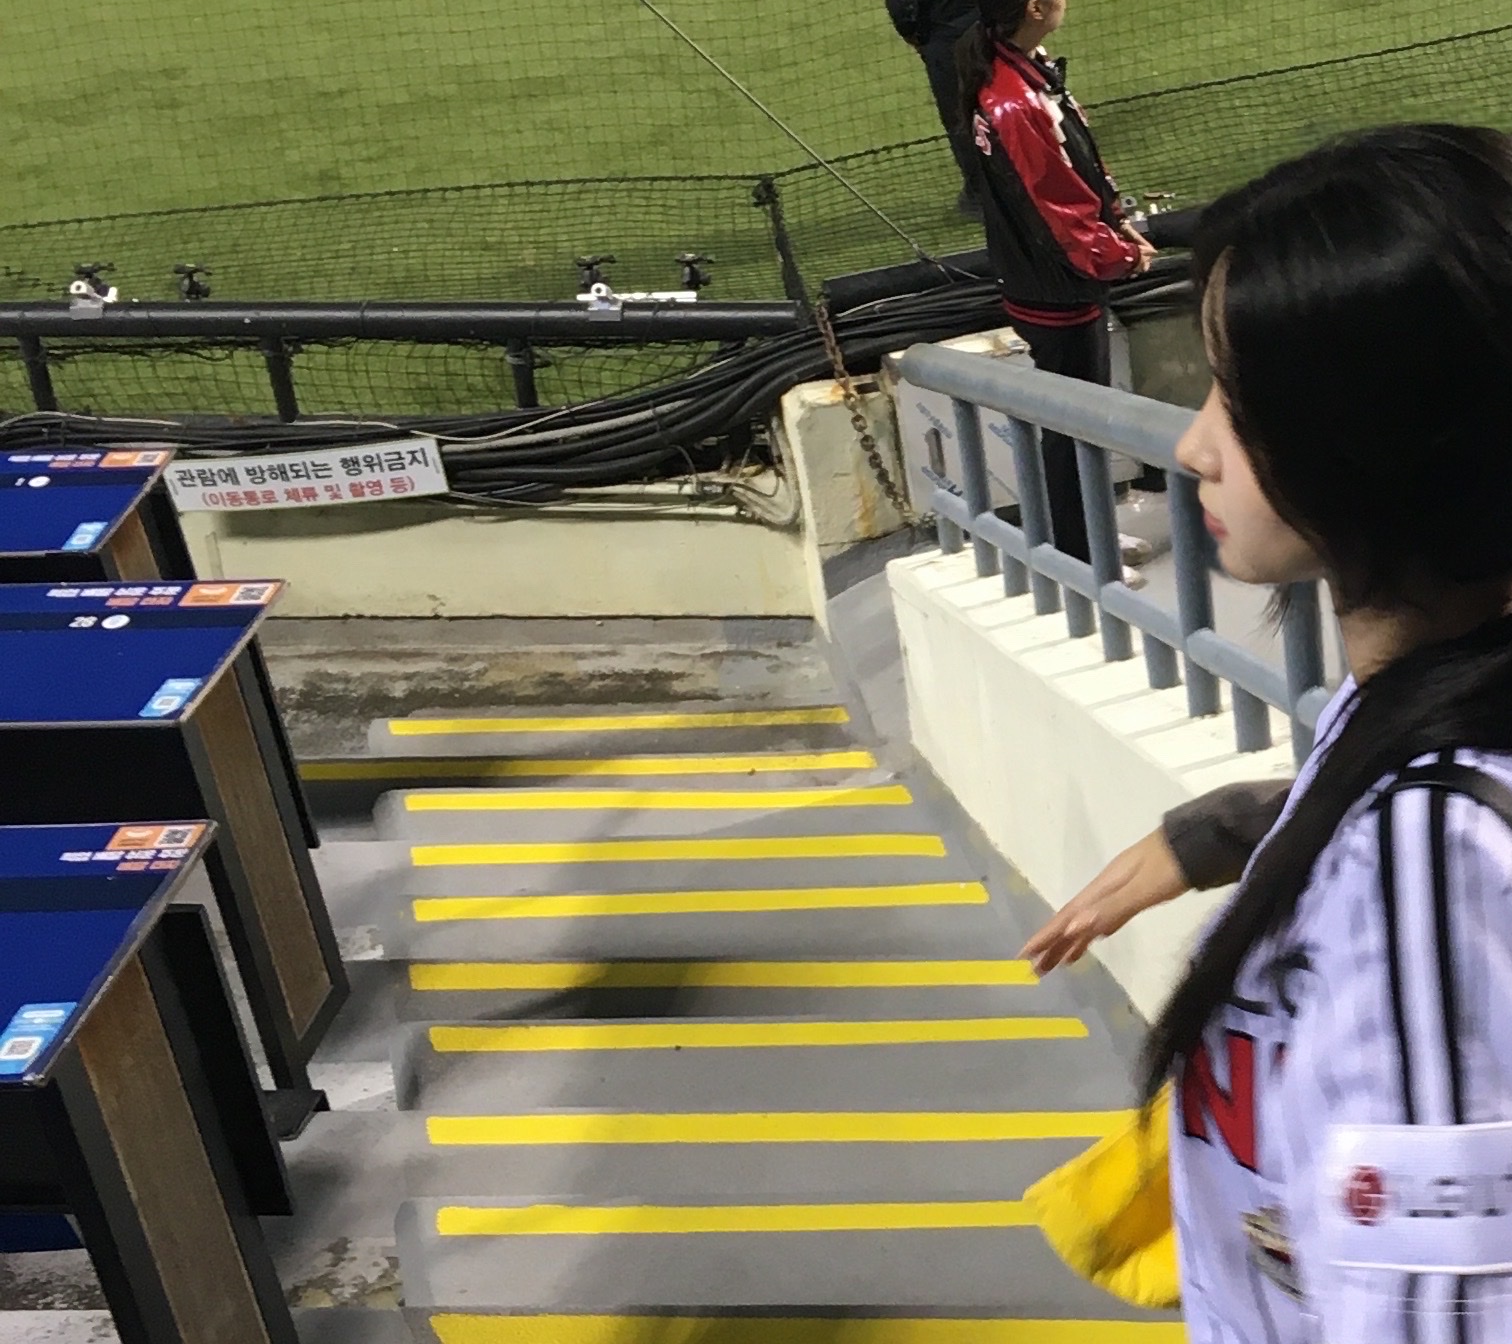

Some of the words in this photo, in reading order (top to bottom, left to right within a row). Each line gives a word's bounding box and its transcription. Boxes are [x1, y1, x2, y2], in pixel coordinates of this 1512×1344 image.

[175, 467, 240, 489] 관람에
[245, 460, 333, 485] 방해되는
[339, 447, 430, 477] 행위금지
[202, 490, 279, 507] (이동통로
[285, 486, 319, 505] 체류
[324, 484, 344, 501] 및
[349, 479, 384, 498] 촬영
[389, 476, 415, 494] 등)
